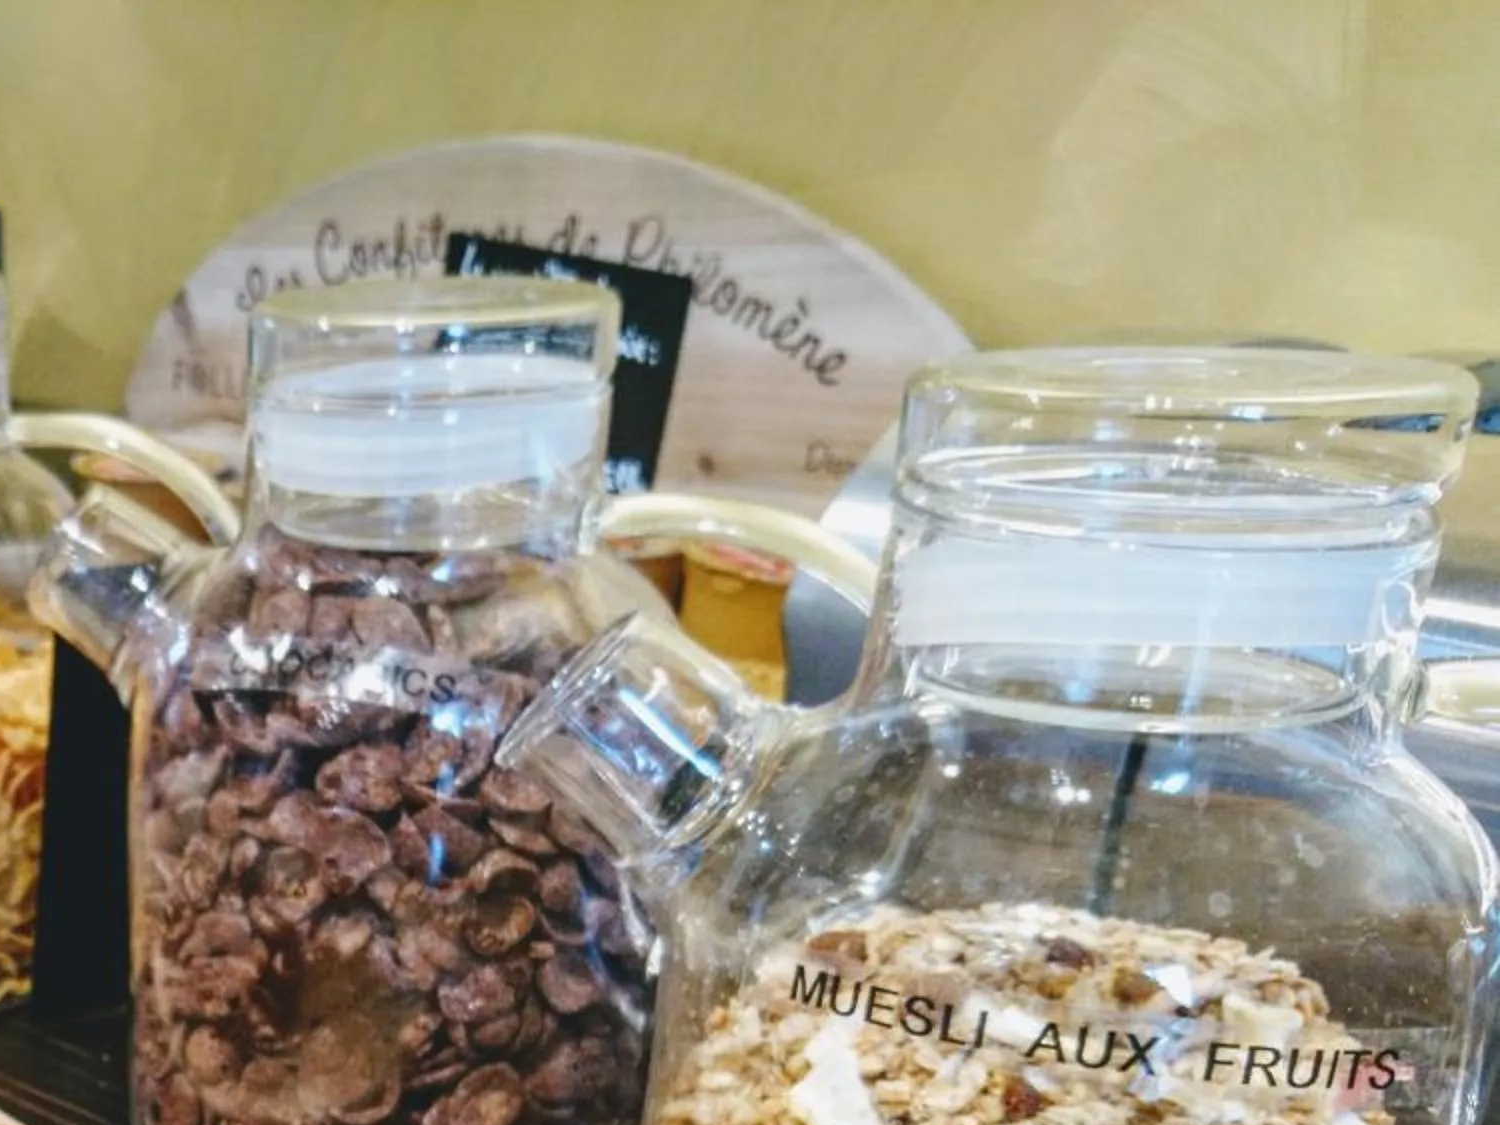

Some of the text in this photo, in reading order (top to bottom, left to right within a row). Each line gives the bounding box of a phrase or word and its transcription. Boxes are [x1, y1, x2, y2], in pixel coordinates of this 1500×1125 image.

[789, 963, 1400, 1091] MUESLI AUX FRUITS
